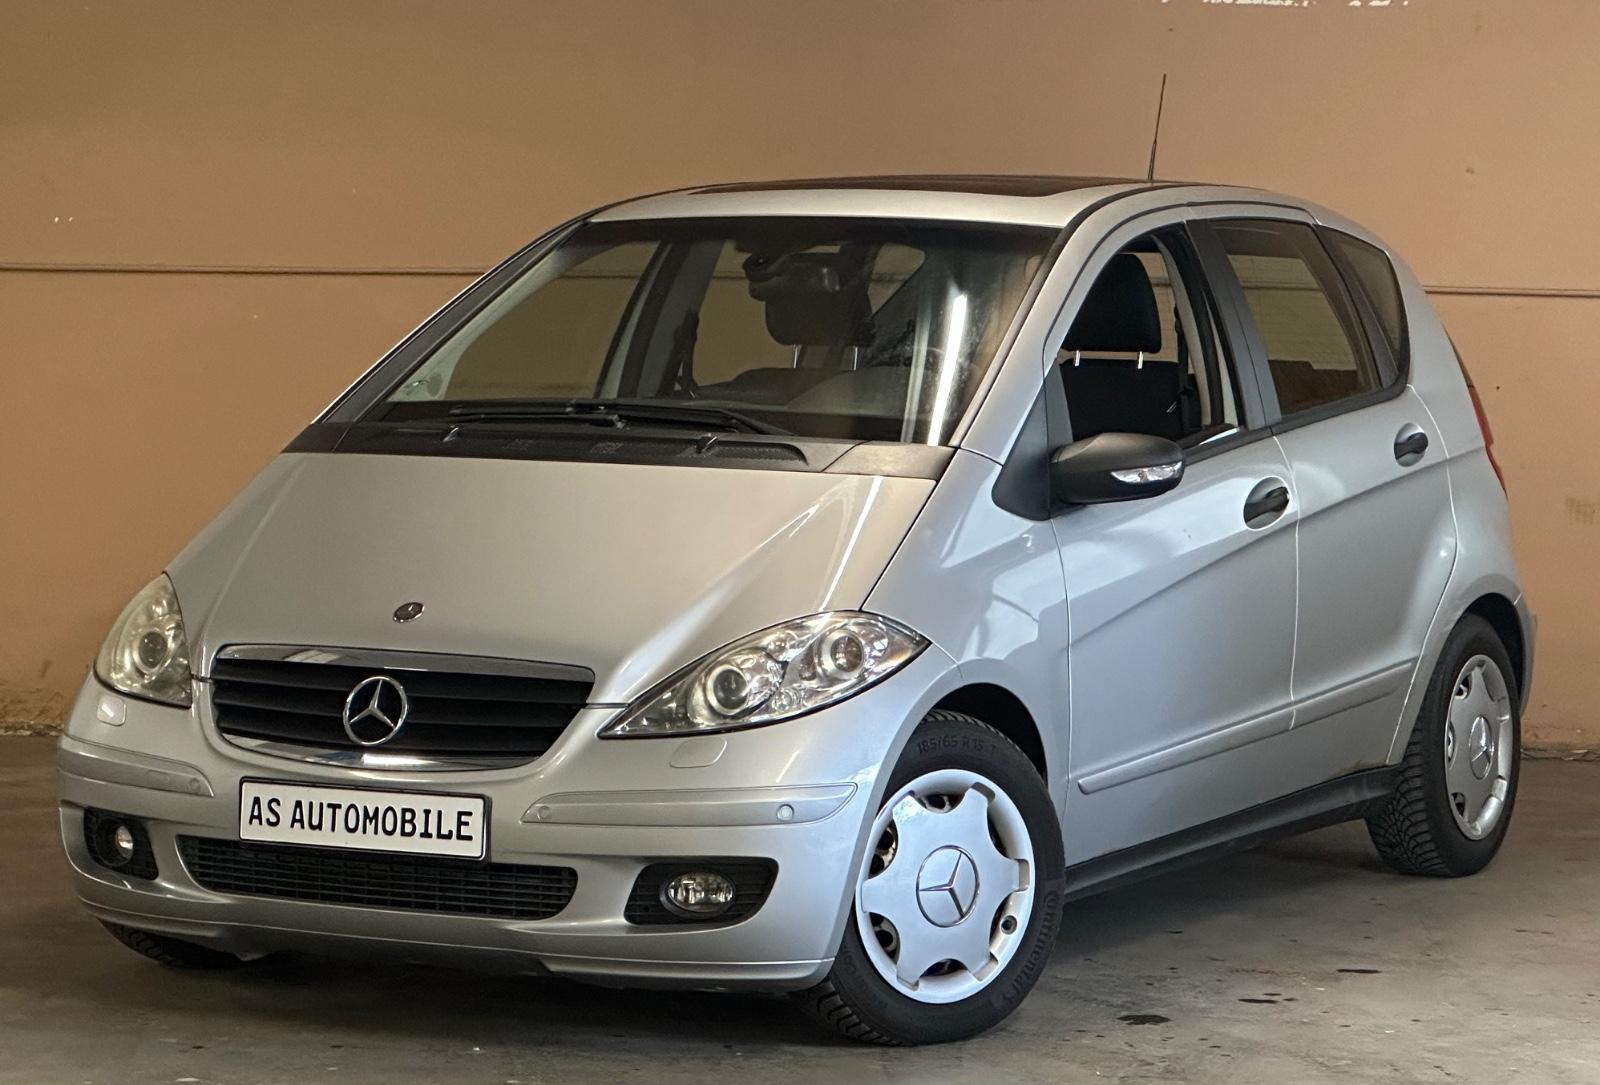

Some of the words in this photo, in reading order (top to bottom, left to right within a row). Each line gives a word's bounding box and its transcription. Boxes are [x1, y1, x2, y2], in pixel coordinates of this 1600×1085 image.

[917, 735, 958, 754] 185/65
[248, 796, 282, 828] AS
[290, 799, 475, 842] AUTOMOBILE
